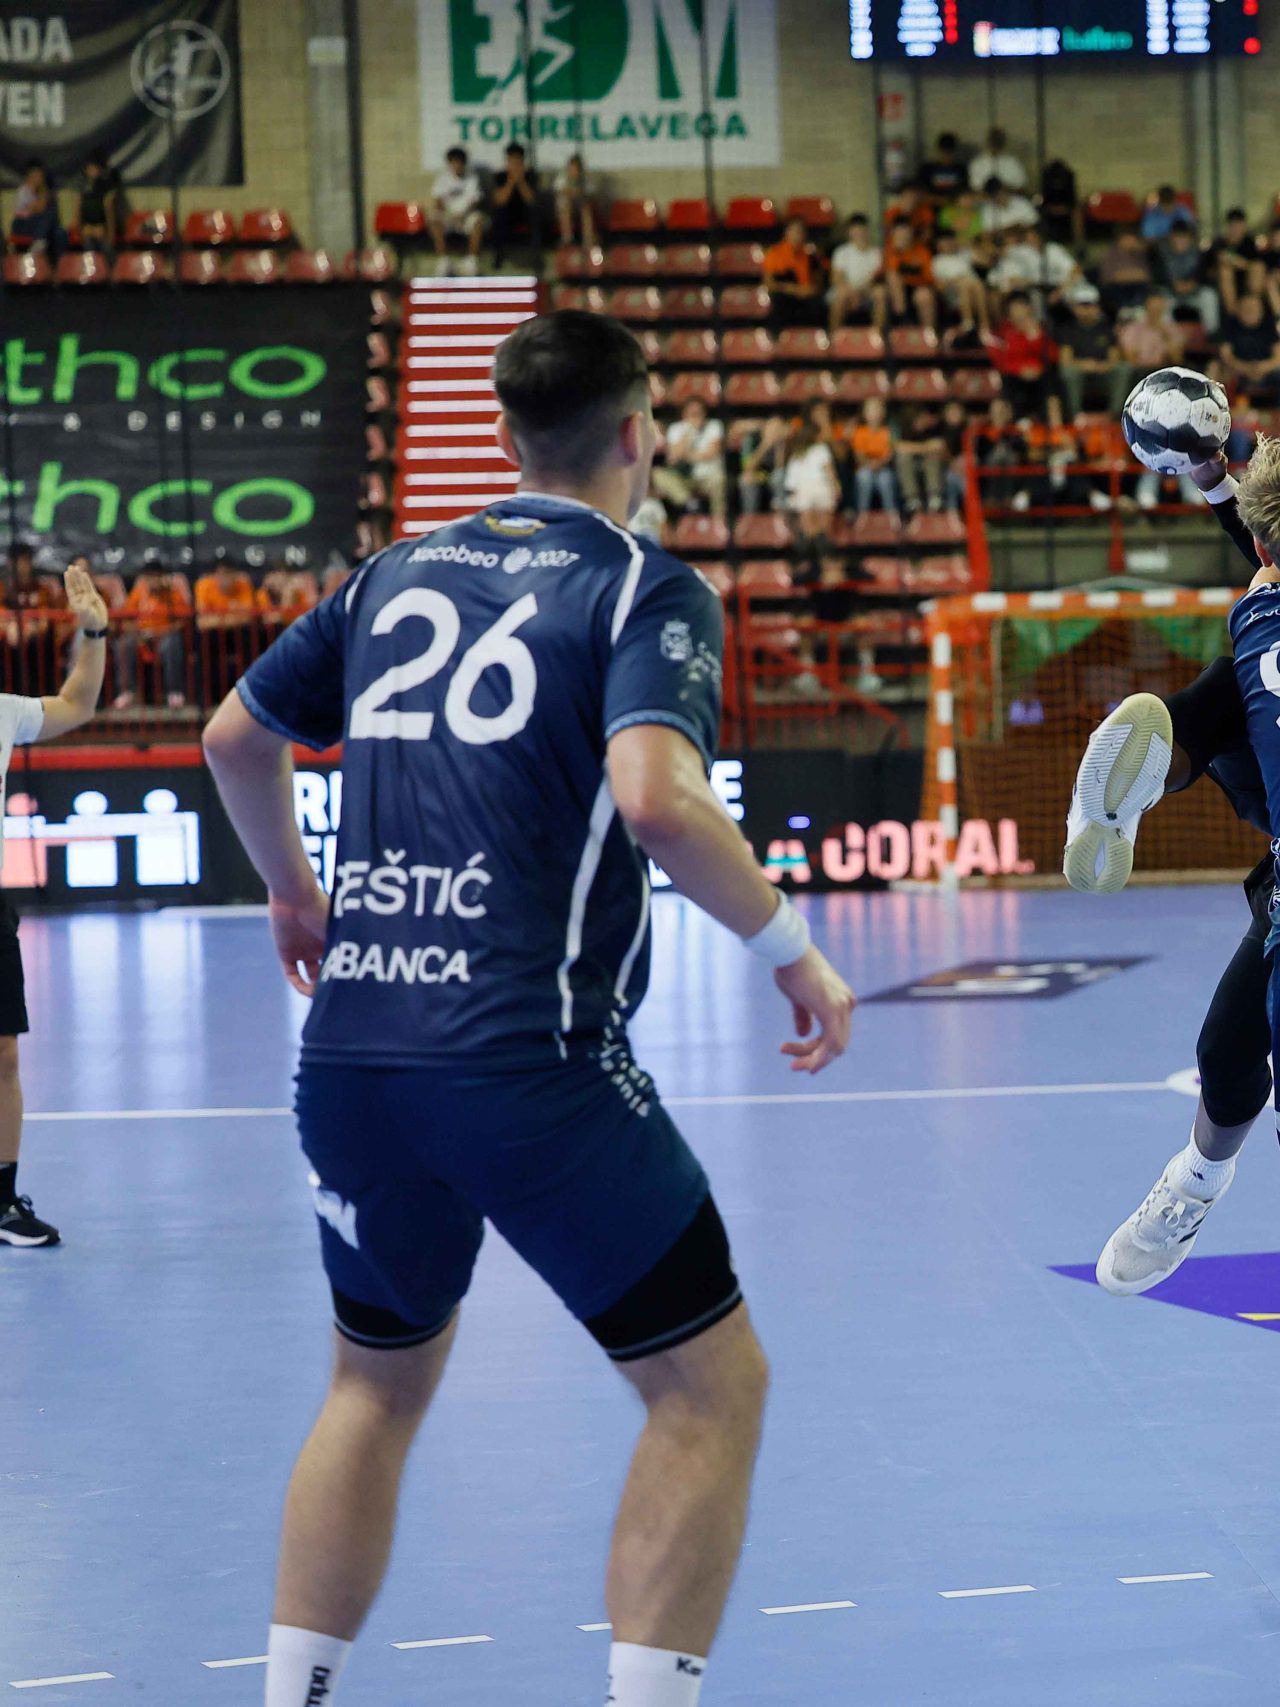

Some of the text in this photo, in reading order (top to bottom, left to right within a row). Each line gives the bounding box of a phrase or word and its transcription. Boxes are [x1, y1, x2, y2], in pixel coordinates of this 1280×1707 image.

[454, 111, 748, 141] TORRELAVEGA
[348, 586, 539, 746] 26
[821, 818, 1036, 883] CORAL
